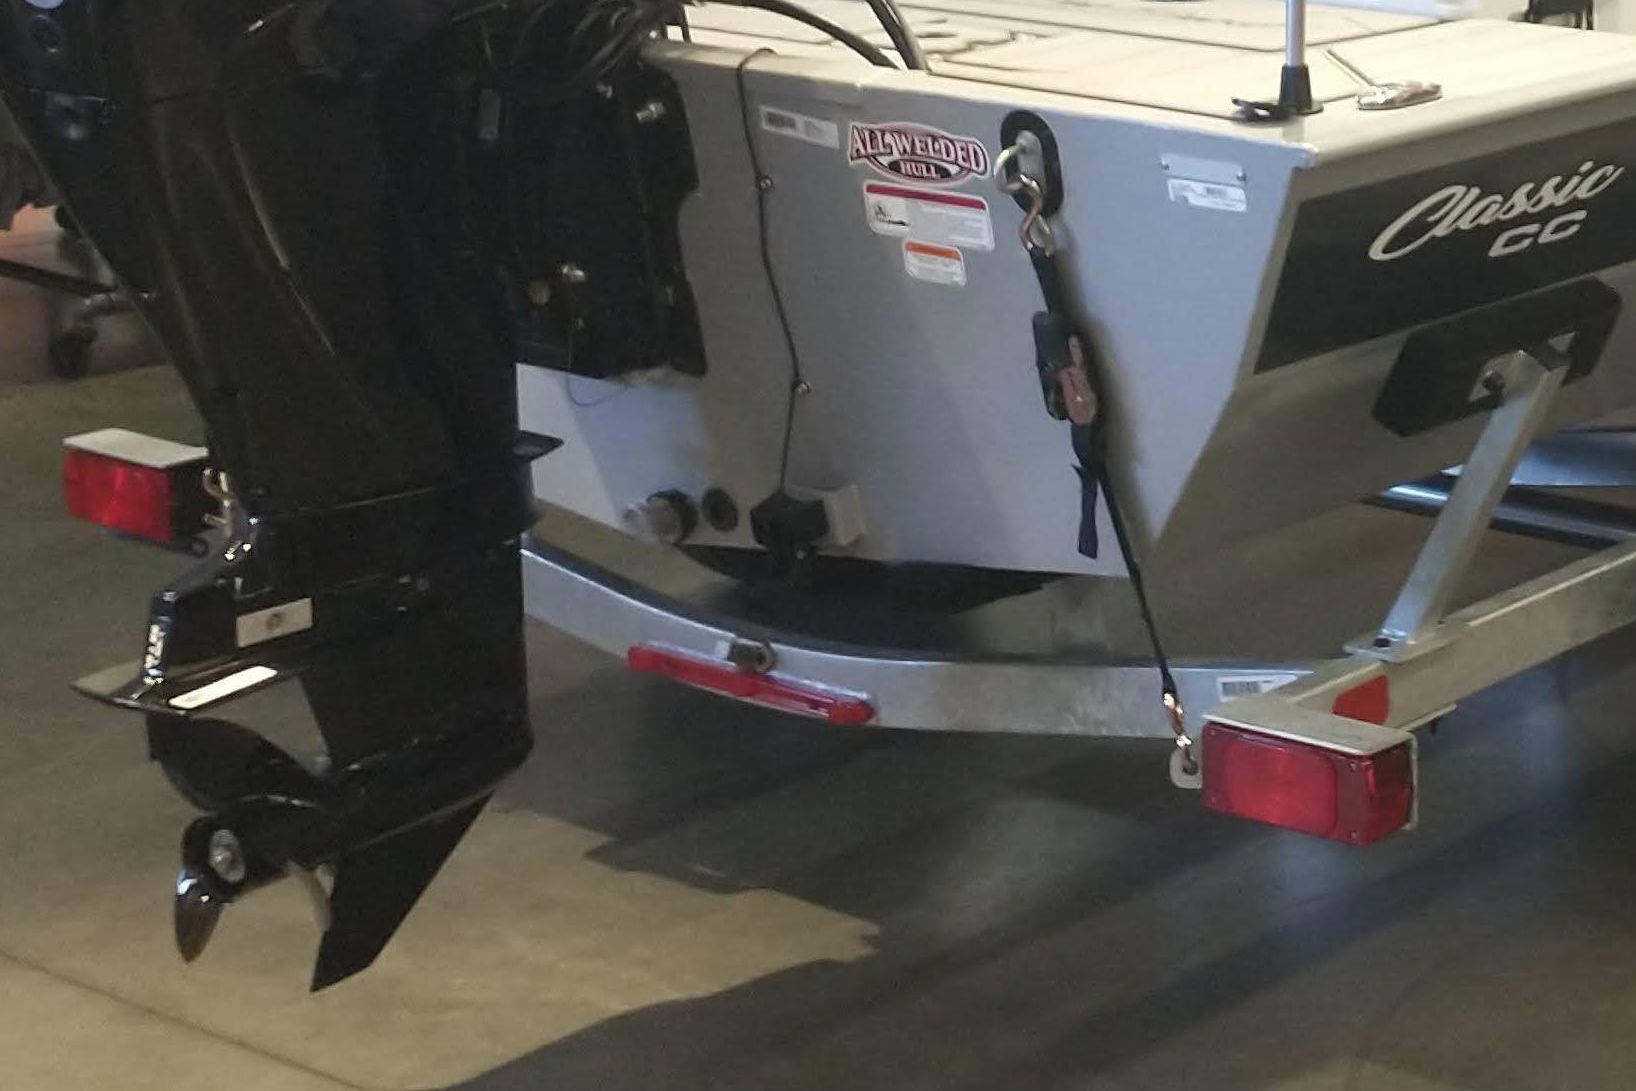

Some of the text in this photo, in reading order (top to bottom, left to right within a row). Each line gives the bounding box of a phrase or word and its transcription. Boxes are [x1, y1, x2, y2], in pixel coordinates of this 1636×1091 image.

[899, 161, 938, 178] HULL
[1368, 160, 1624, 261] Classic
[1488, 209, 1588, 257] CC
